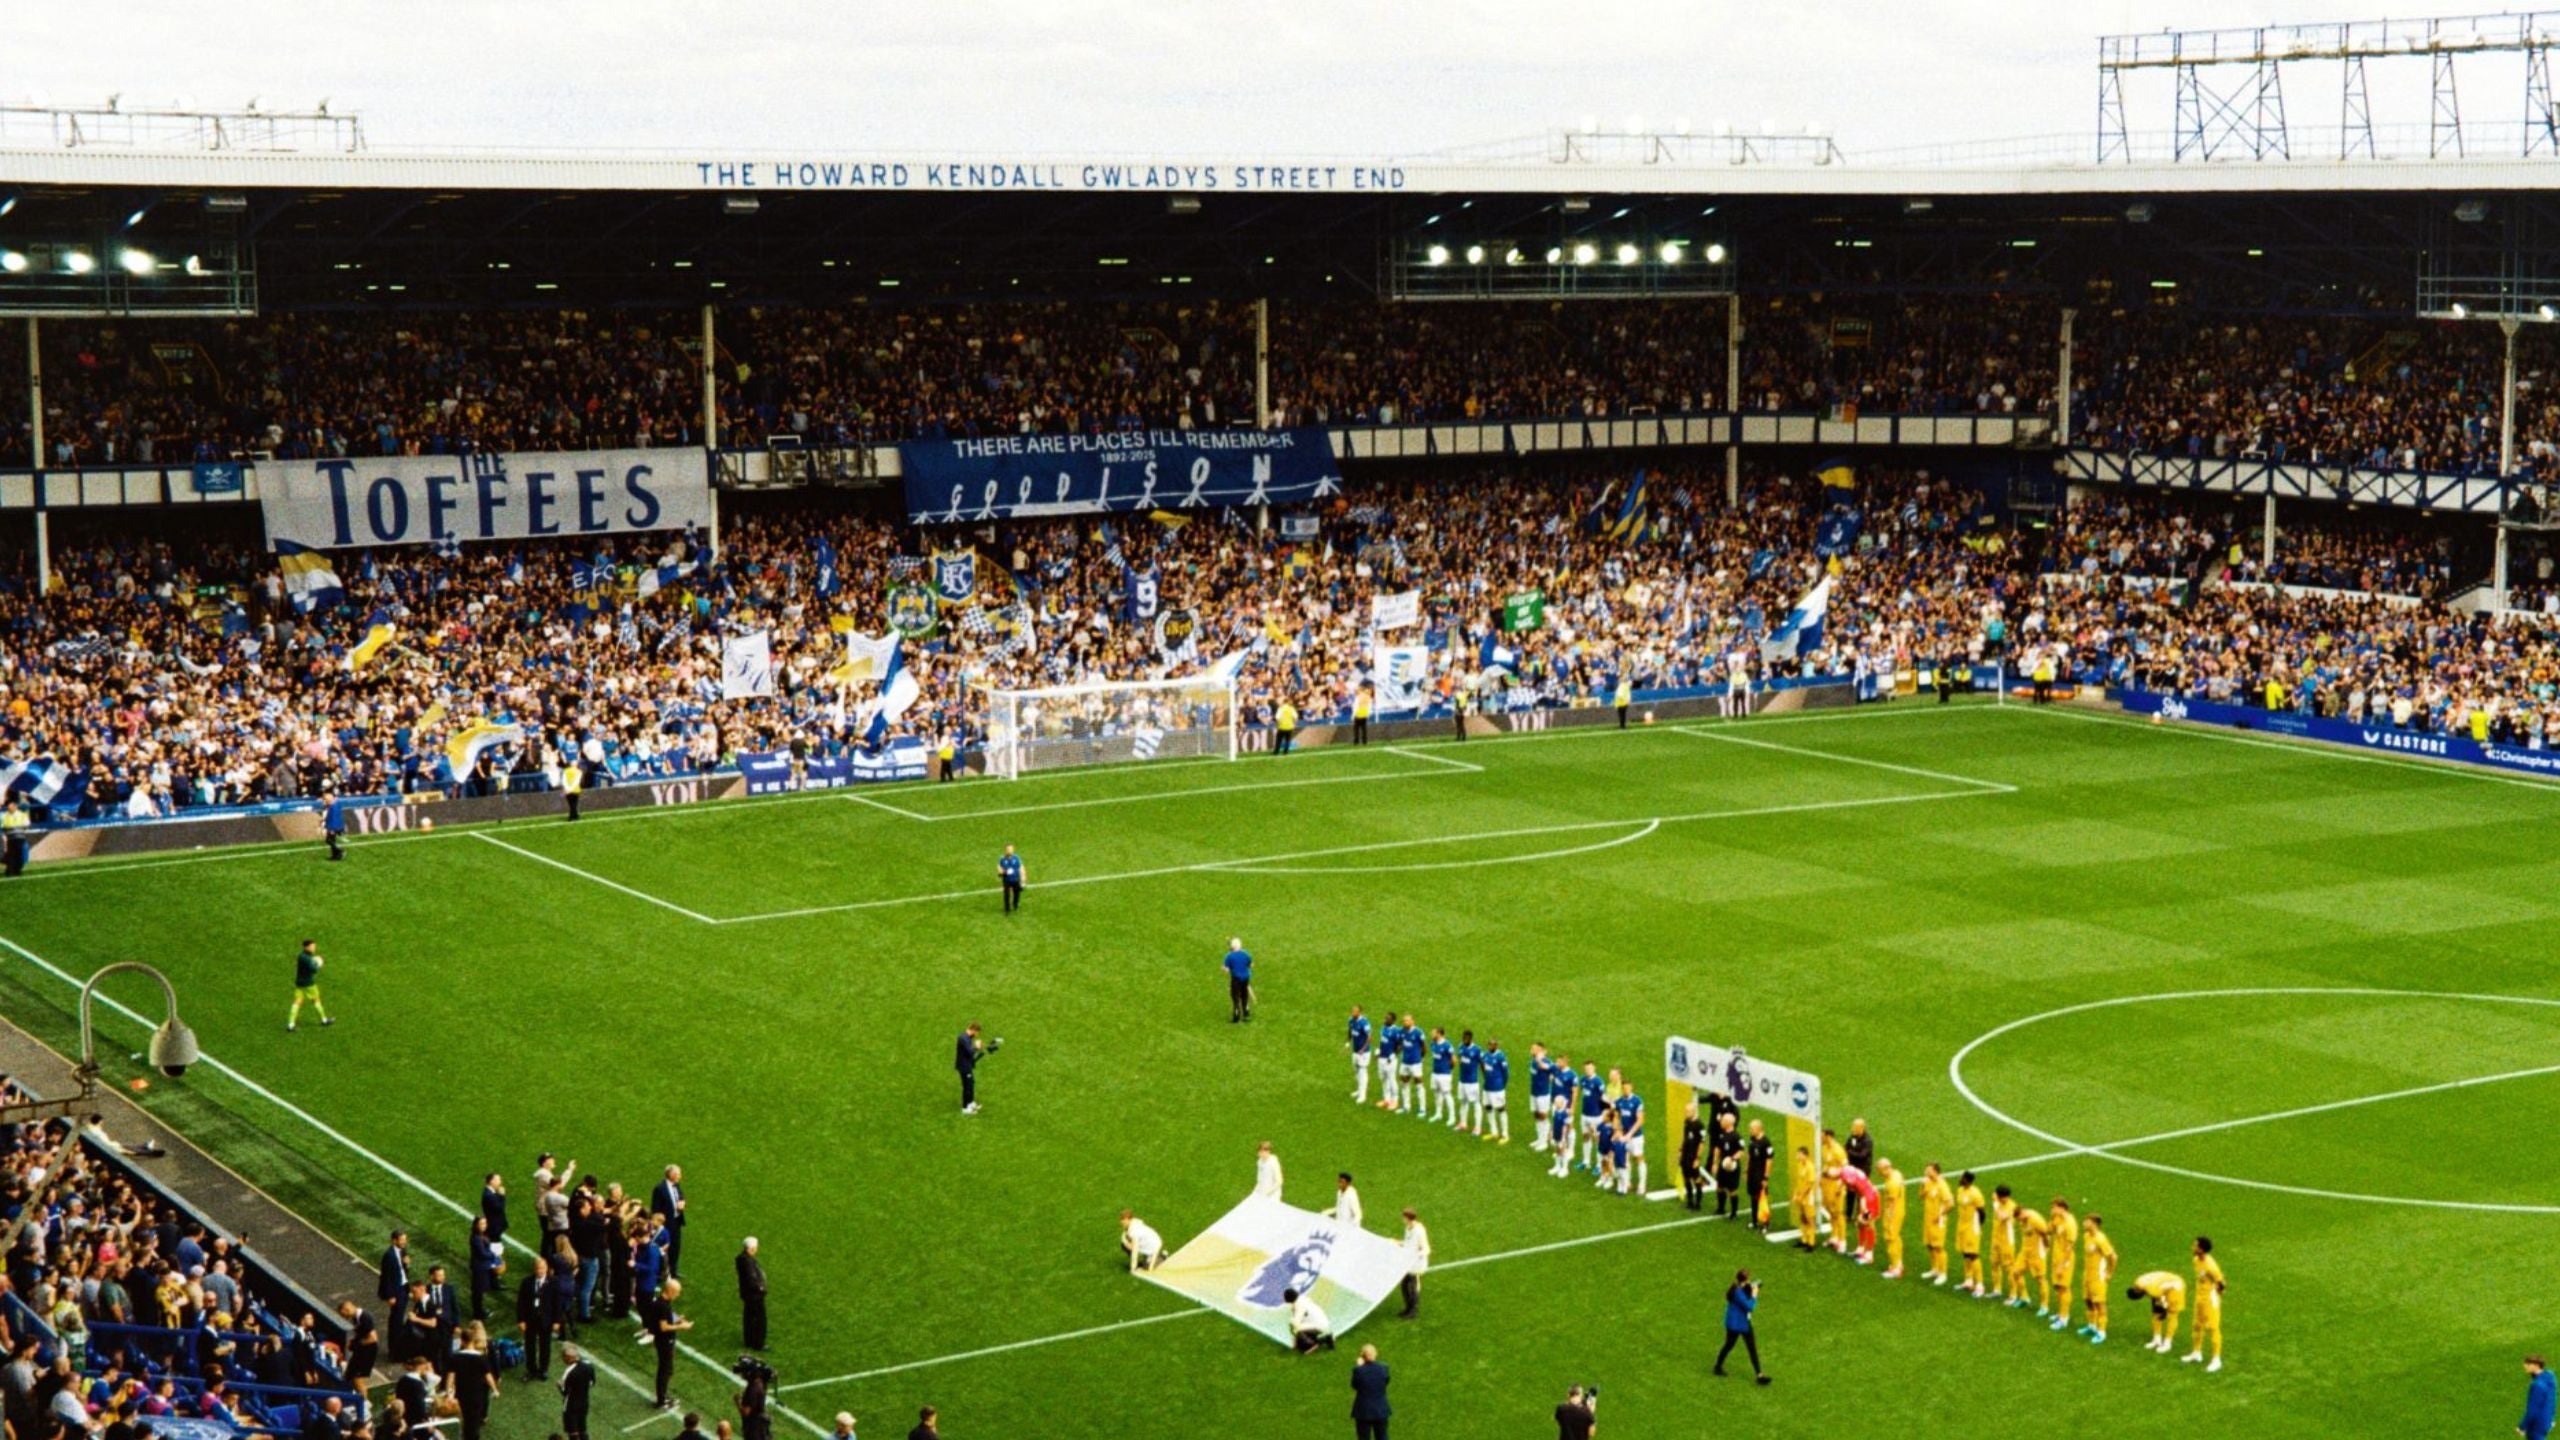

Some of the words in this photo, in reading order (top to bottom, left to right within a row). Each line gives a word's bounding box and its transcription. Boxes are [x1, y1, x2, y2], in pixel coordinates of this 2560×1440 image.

[697, 163, 756, 187] THE
[776, 163, 909, 187] HOWARD
[928, 164, 1064, 187] KENDALL
[1082, 166, 1218, 188] GWLADYS
[1235, 166, 1337, 189] STREET
[1354, 168, 1405, 189] END
[953, 438, 1023, 459] THERE
[1027, 437, 1066, 456] ARE
[1069, 433, 1147, 453] PLACES
[1150, 432, 1183, 448] I'LL
[1186, 431, 1295, 450] REMEMBER
[458, 453, 506, 483] THE
[315, 460, 660, 546] TOFFEES
[1136, 580, 1157, 617] 9
[1509, 711, 1554, 732] YOU
[2384, 732, 2447, 755] CASTORE
[2501, 750, 2551, 767] Christopher
[651, 780, 709, 807] YOU
[354, 804, 417, 835] YOU
